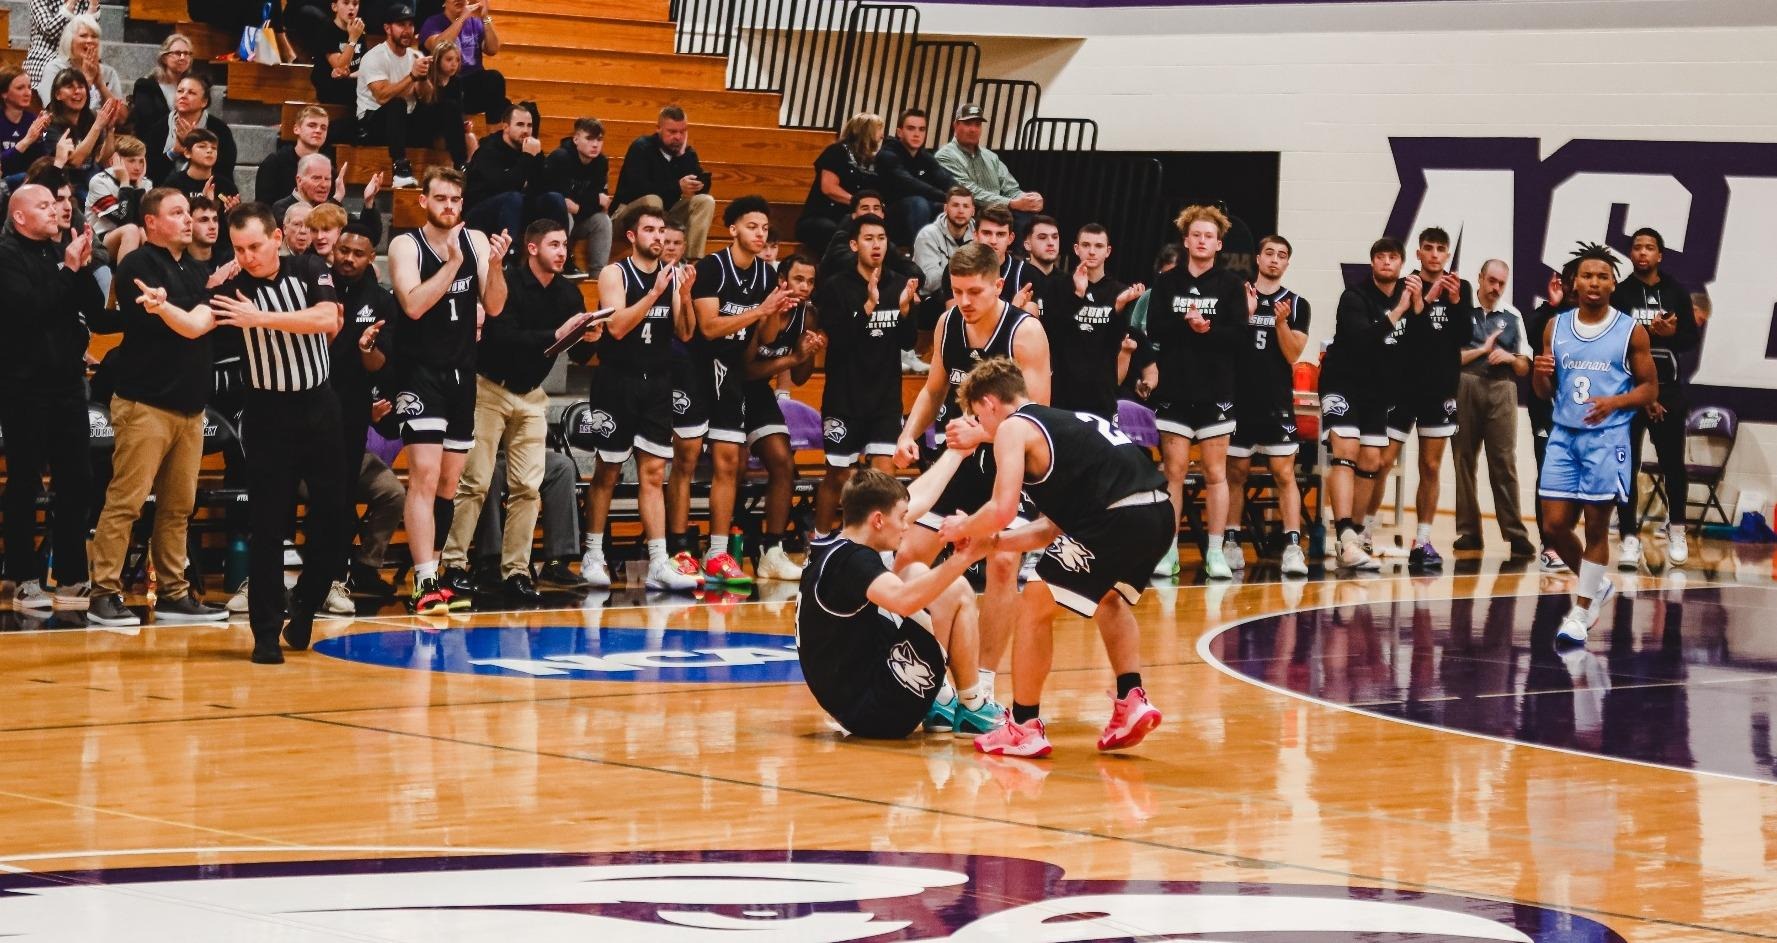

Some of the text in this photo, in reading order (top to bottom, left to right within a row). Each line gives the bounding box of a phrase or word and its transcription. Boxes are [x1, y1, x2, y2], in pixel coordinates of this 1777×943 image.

[449, 299, 459, 322] 1
[1078, 306, 1113, 318] BURY
[1173, 297, 1219, 309] ASBURY
[870, 310, 901, 322] BURY
[1248, 315, 1276, 328] SBUR
[641, 322, 652, 344] 4
[1255, 330, 1267, 350] 5
[1560, 354, 1613, 372] Covenant
[1572, 375, 1592, 405] 3
[1075, 411, 1133, 447] 2
[467, 643, 800, 675] NCA
